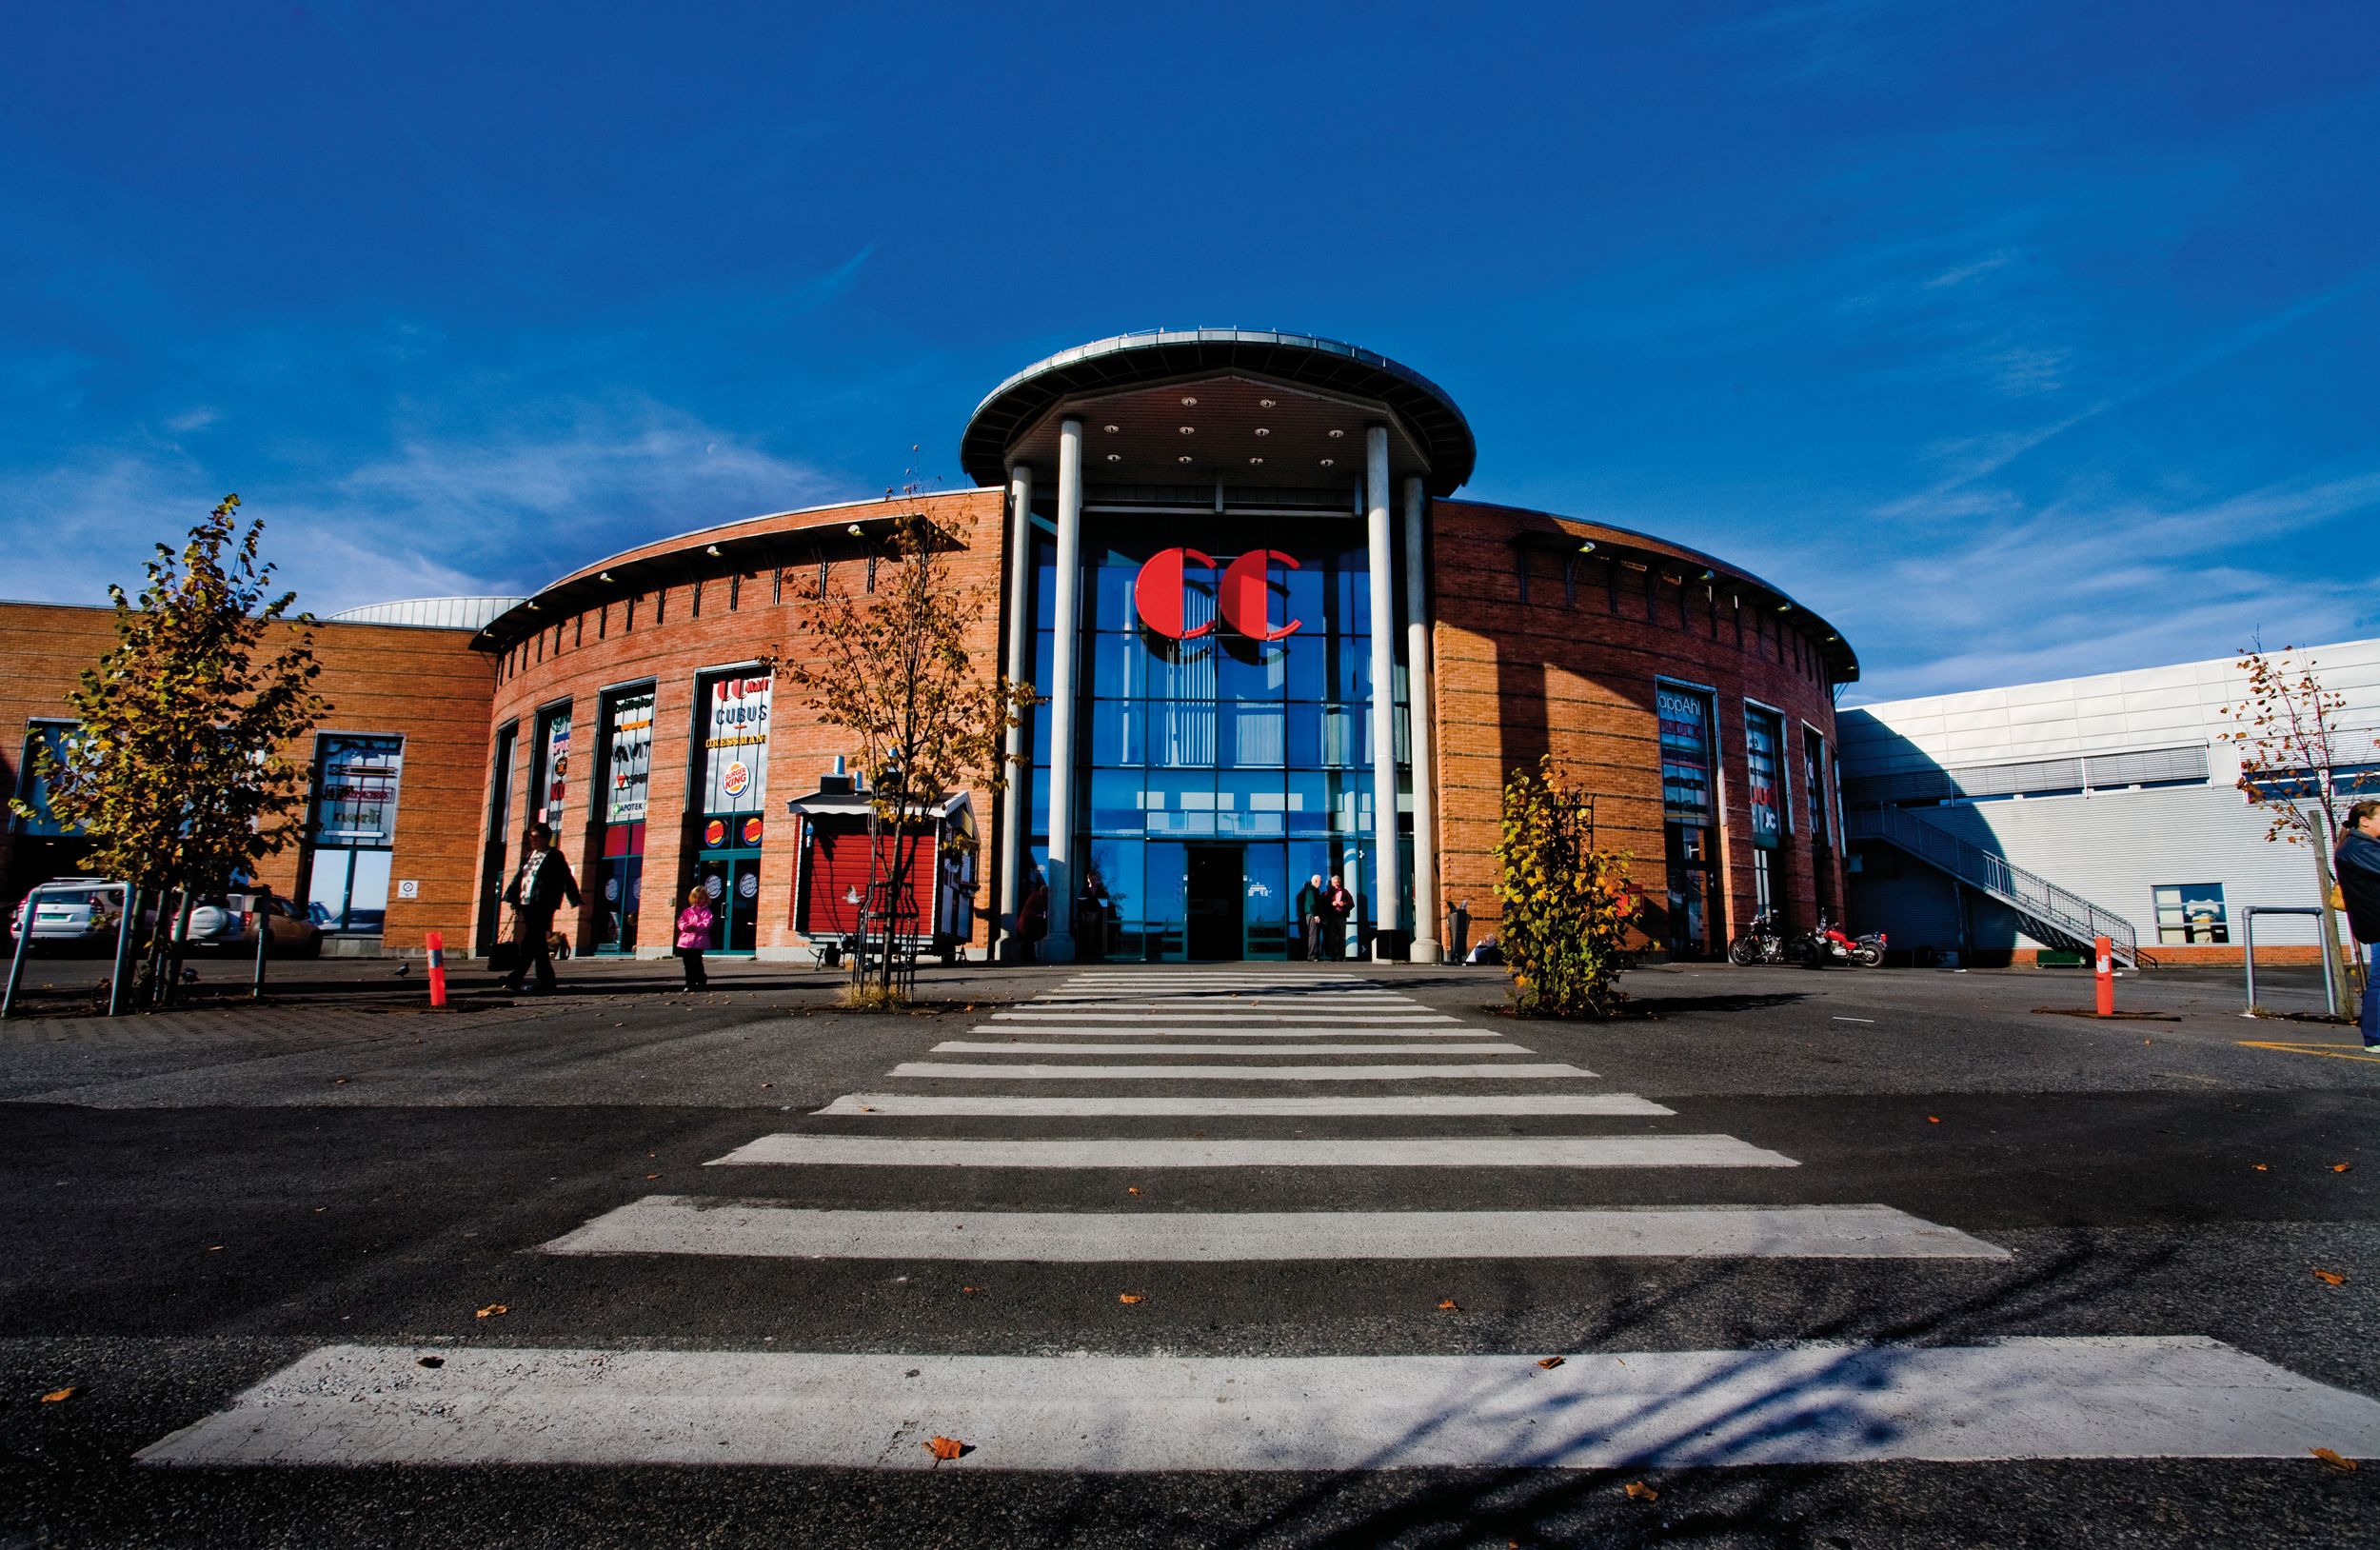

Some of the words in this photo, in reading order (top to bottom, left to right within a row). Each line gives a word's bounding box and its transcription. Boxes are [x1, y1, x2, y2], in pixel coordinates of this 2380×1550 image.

[1135, 547, 1301, 641] CC
[1658, 696, 1701, 716] appAhl
[716, 705, 767, 725] CUBUS
[725, 767, 746, 781] BURGER
[725, 774, 747, 789] KING
[620, 803, 644, 811] APOTEK
